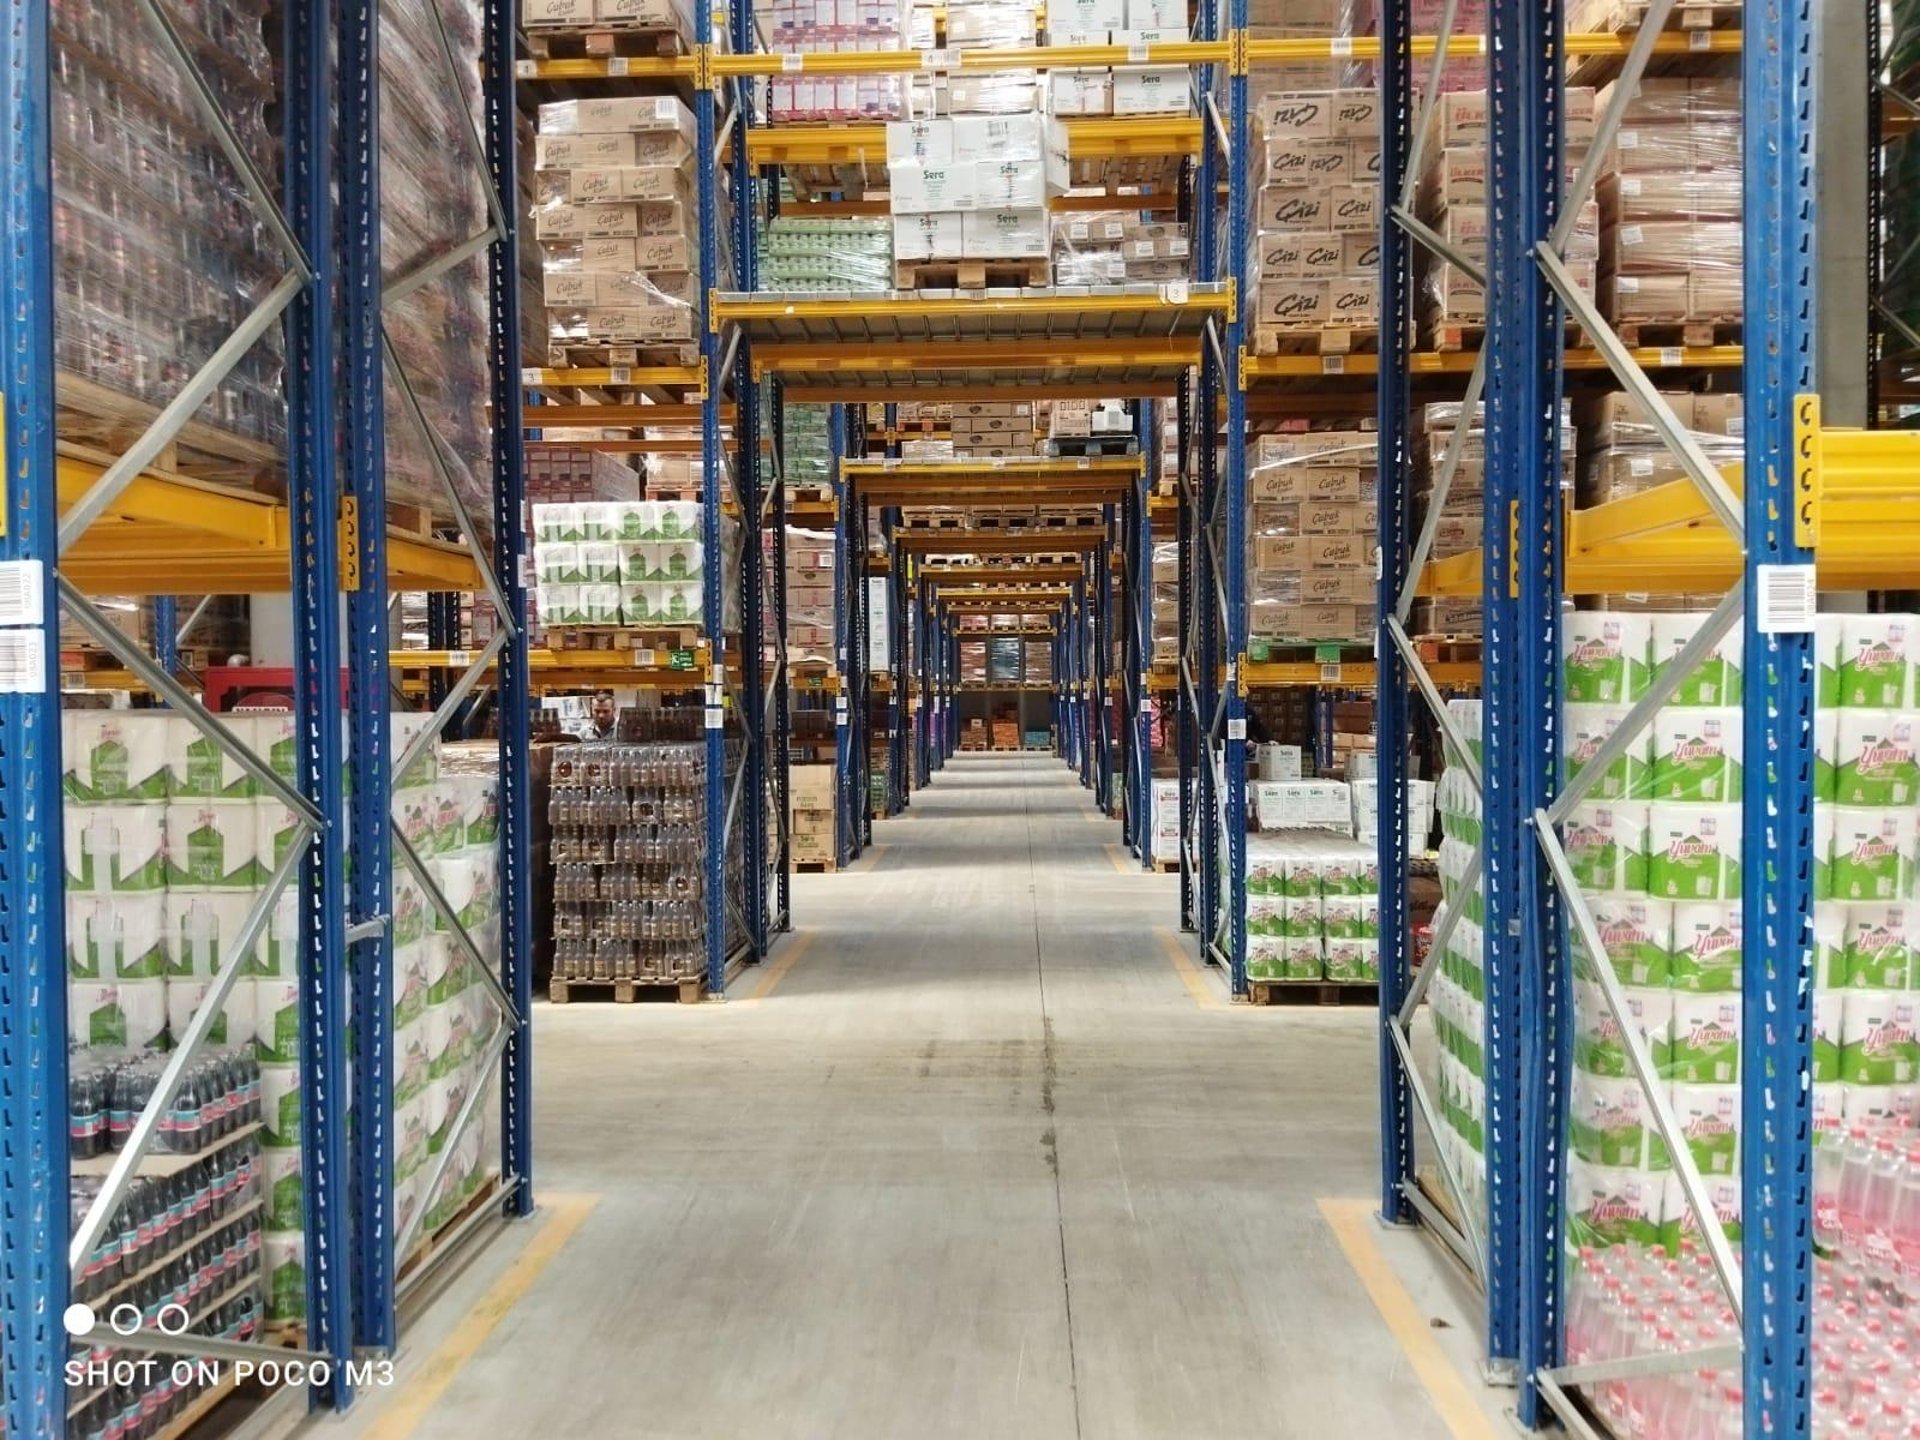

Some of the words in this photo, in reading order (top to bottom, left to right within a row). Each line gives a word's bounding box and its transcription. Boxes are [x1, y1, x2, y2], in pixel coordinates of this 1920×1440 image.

[1141, 75, 1160, 84] Sera
[923, 170, 945, 180] Sera
[996, 214, 1018, 223] Sera
[1860, 745, 1909, 770] Yuvam
